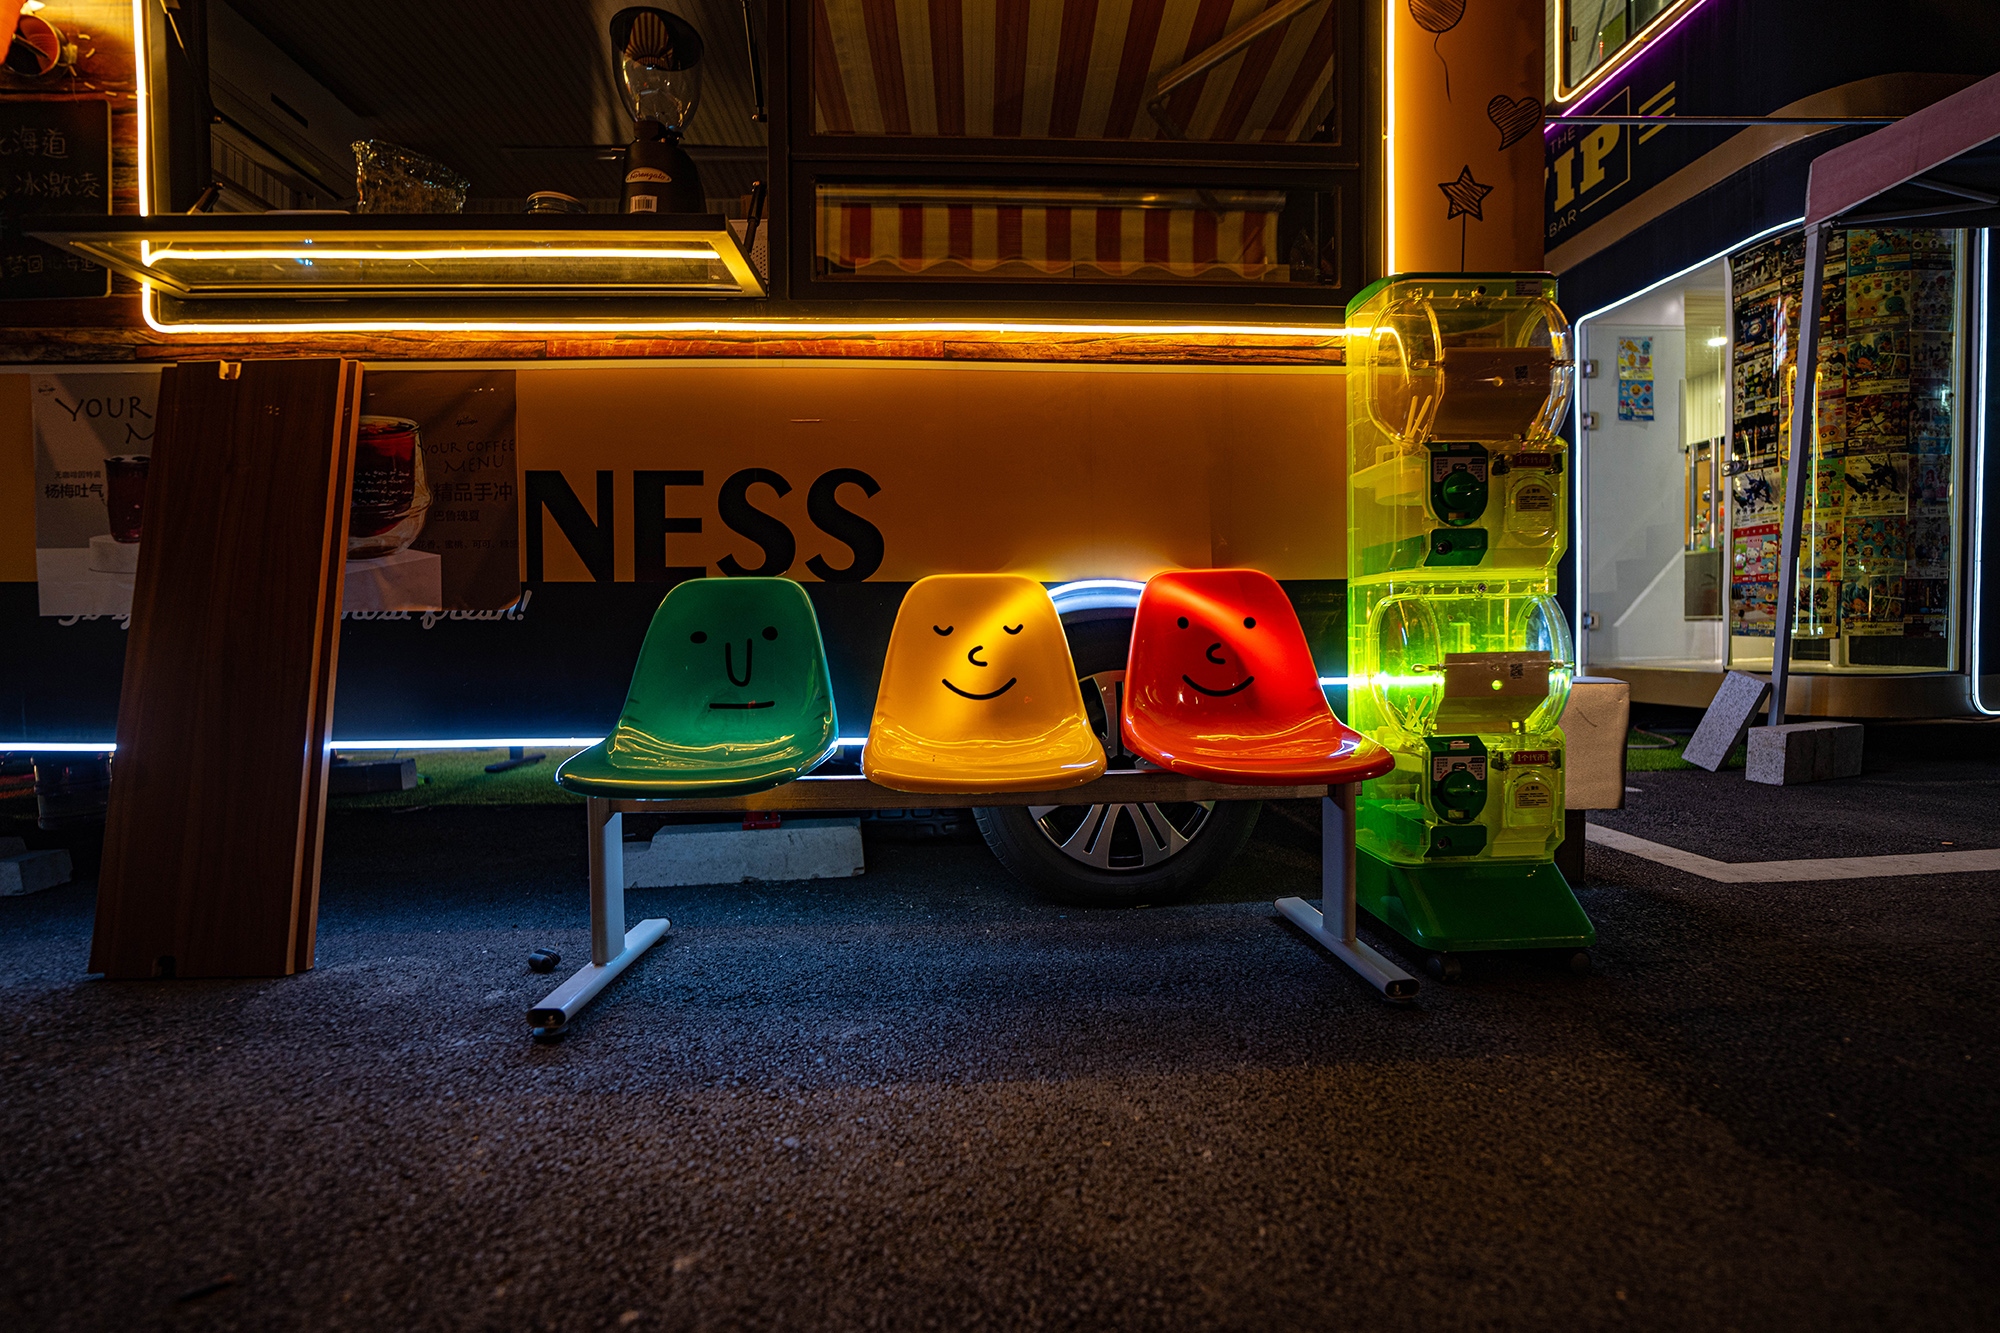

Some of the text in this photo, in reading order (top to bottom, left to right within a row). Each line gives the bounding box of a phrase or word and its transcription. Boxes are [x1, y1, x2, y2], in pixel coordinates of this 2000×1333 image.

[1550, 126, 1577, 154] THE
[1543, 123, 1621, 214] IP
[1549, 208, 1577, 237] BAR
[54, 396, 153, 422] YOUR
[417, 438, 516, 455] YOUR COFFEE
[444, 454, 505, 474] MENU
[45, 483, 104, 499] 杨梅吐气
[433, 482, 513, 502] 精品手冲
[525, 467, 885, 583] NESS
[1517, 752, 1547, 763] 1个代币
